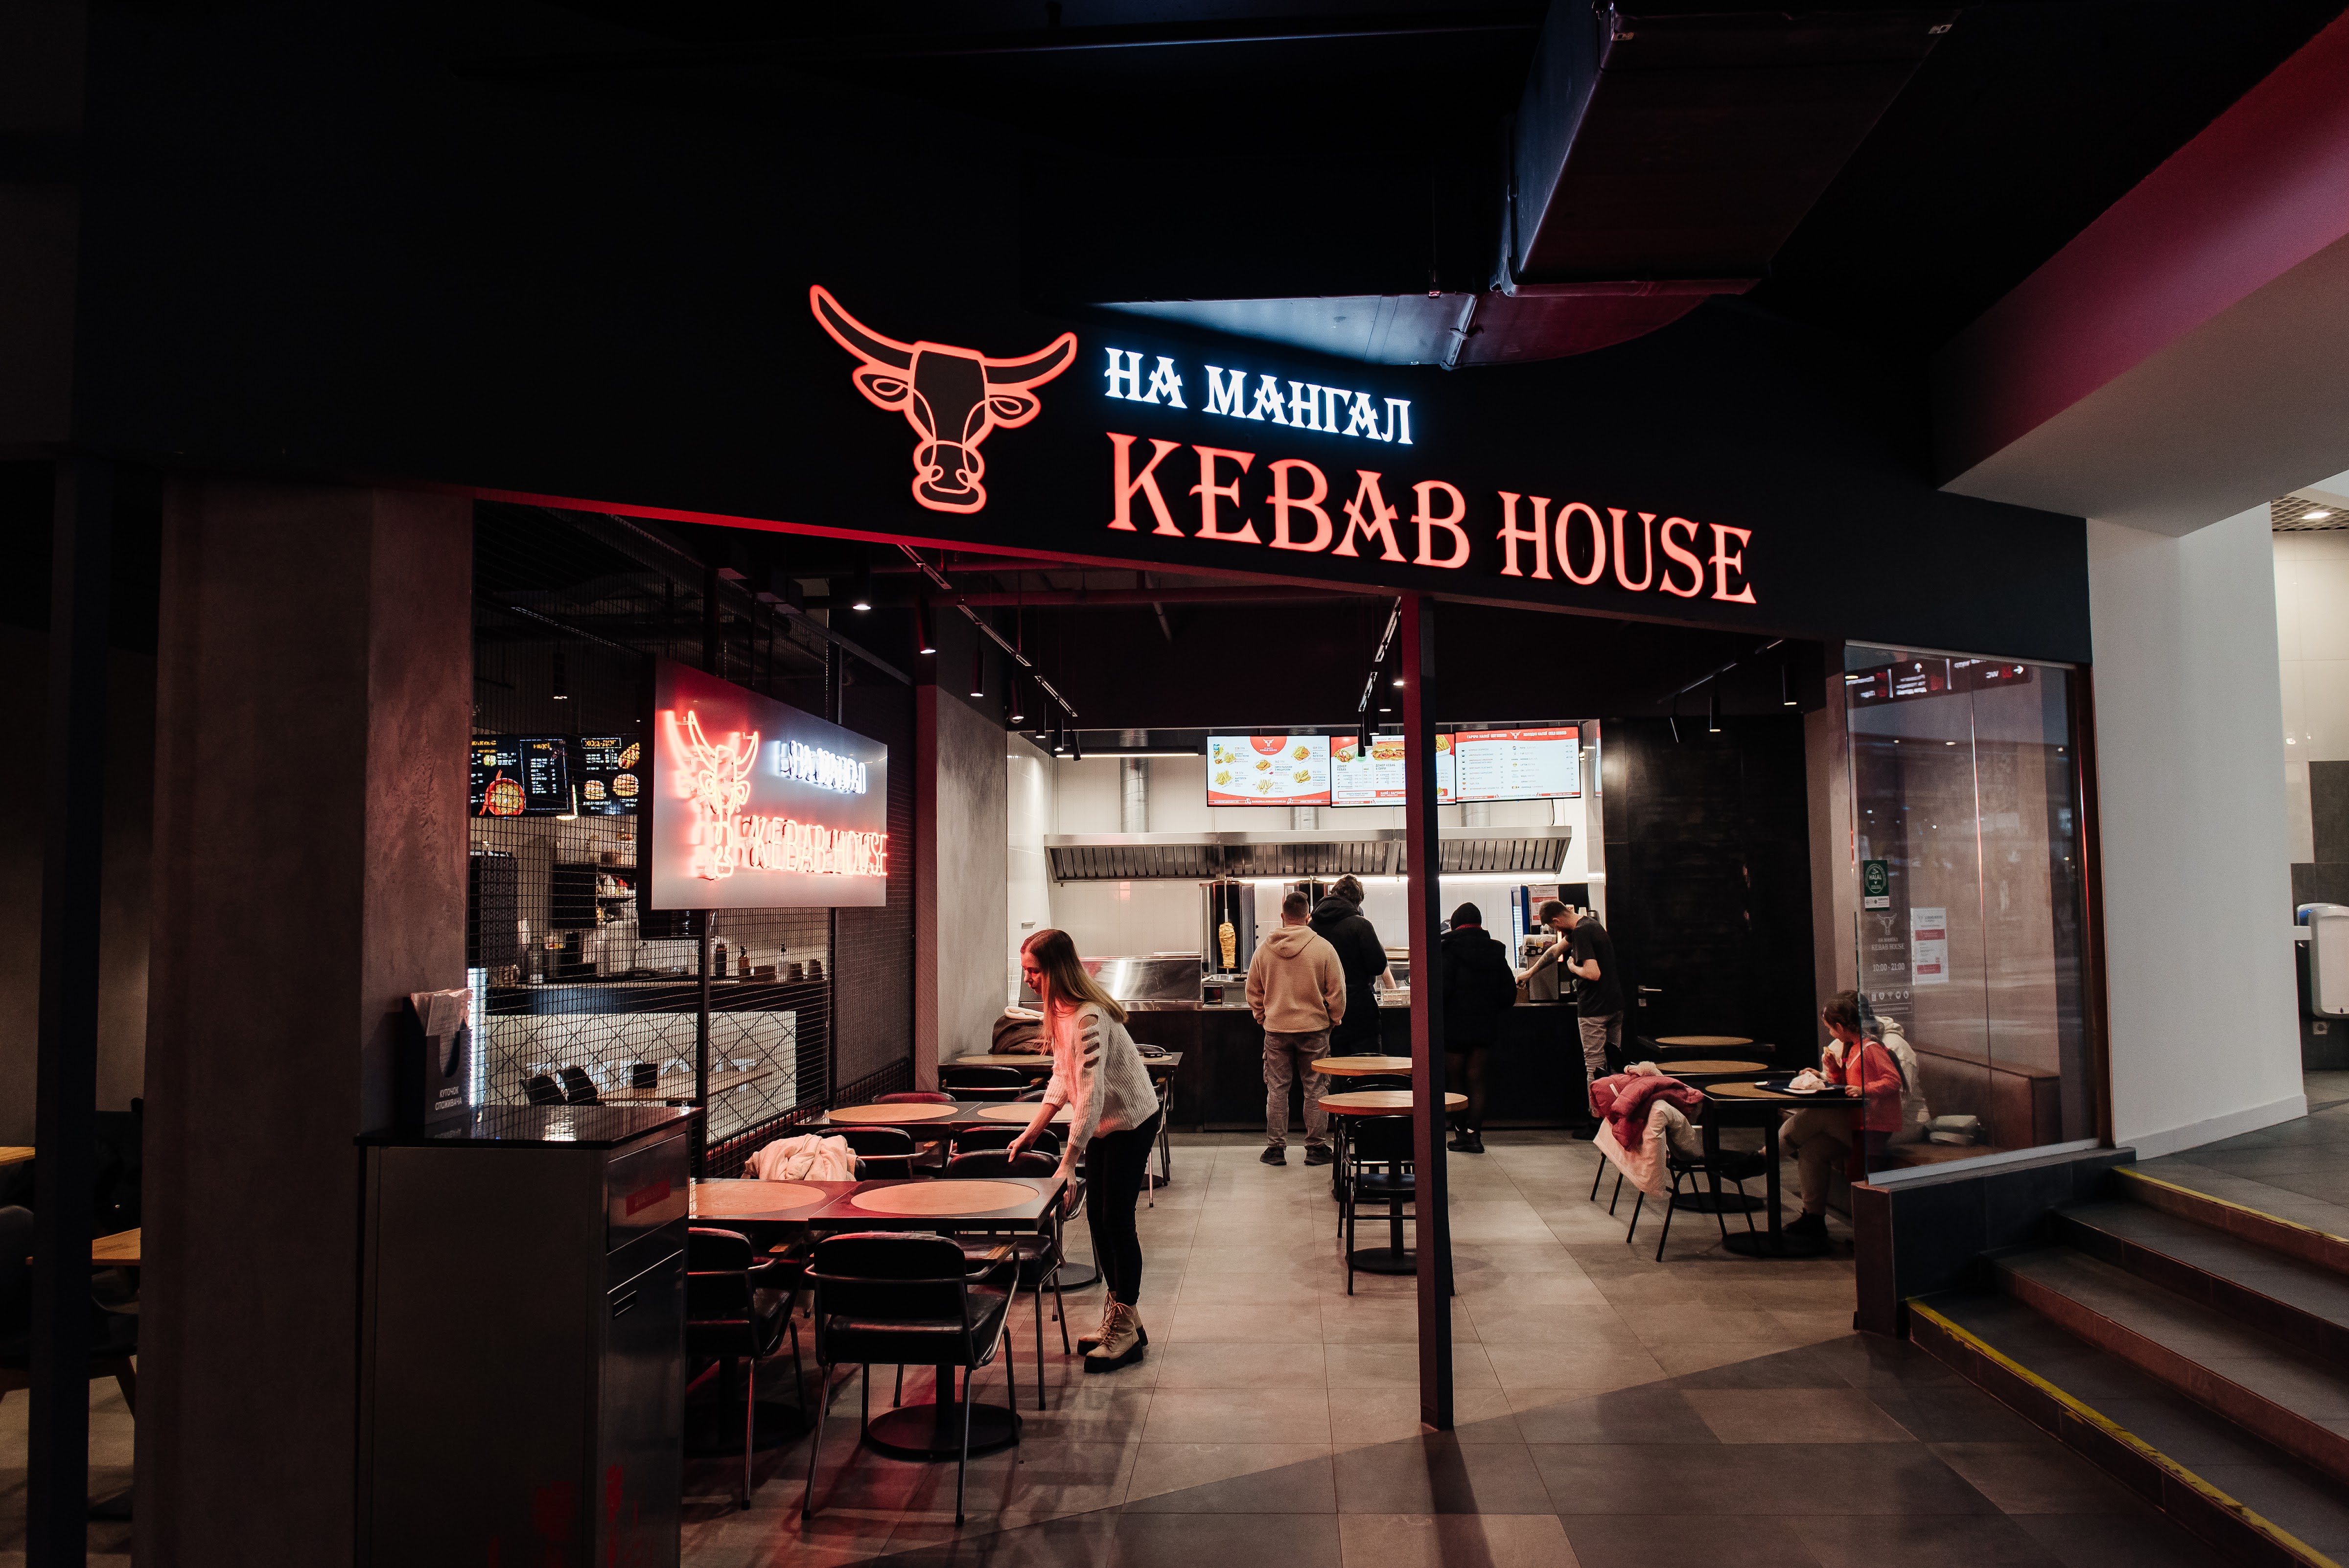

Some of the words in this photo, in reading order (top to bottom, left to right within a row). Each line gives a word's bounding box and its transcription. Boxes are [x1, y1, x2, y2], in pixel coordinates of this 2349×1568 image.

[1105, 346, 1188, 409] НА
[1202, 365, 1413, 445] МАНГАЛ
[1106, 432, 1470, 569] KEBAB
[1496, 490, 1757, 604] HOUSE
[750, 814, 826, 873] KEBAB
[832, 829, 888, 876] HOUSE
[1873, 963, 1887, 971] 10:00
[1891, 963, 1905, 971] 21:00
[435, 1097, 462, 1110] СПОЖИВАЧА
[440, 1086, 459, 1098] КУТОЧОК
